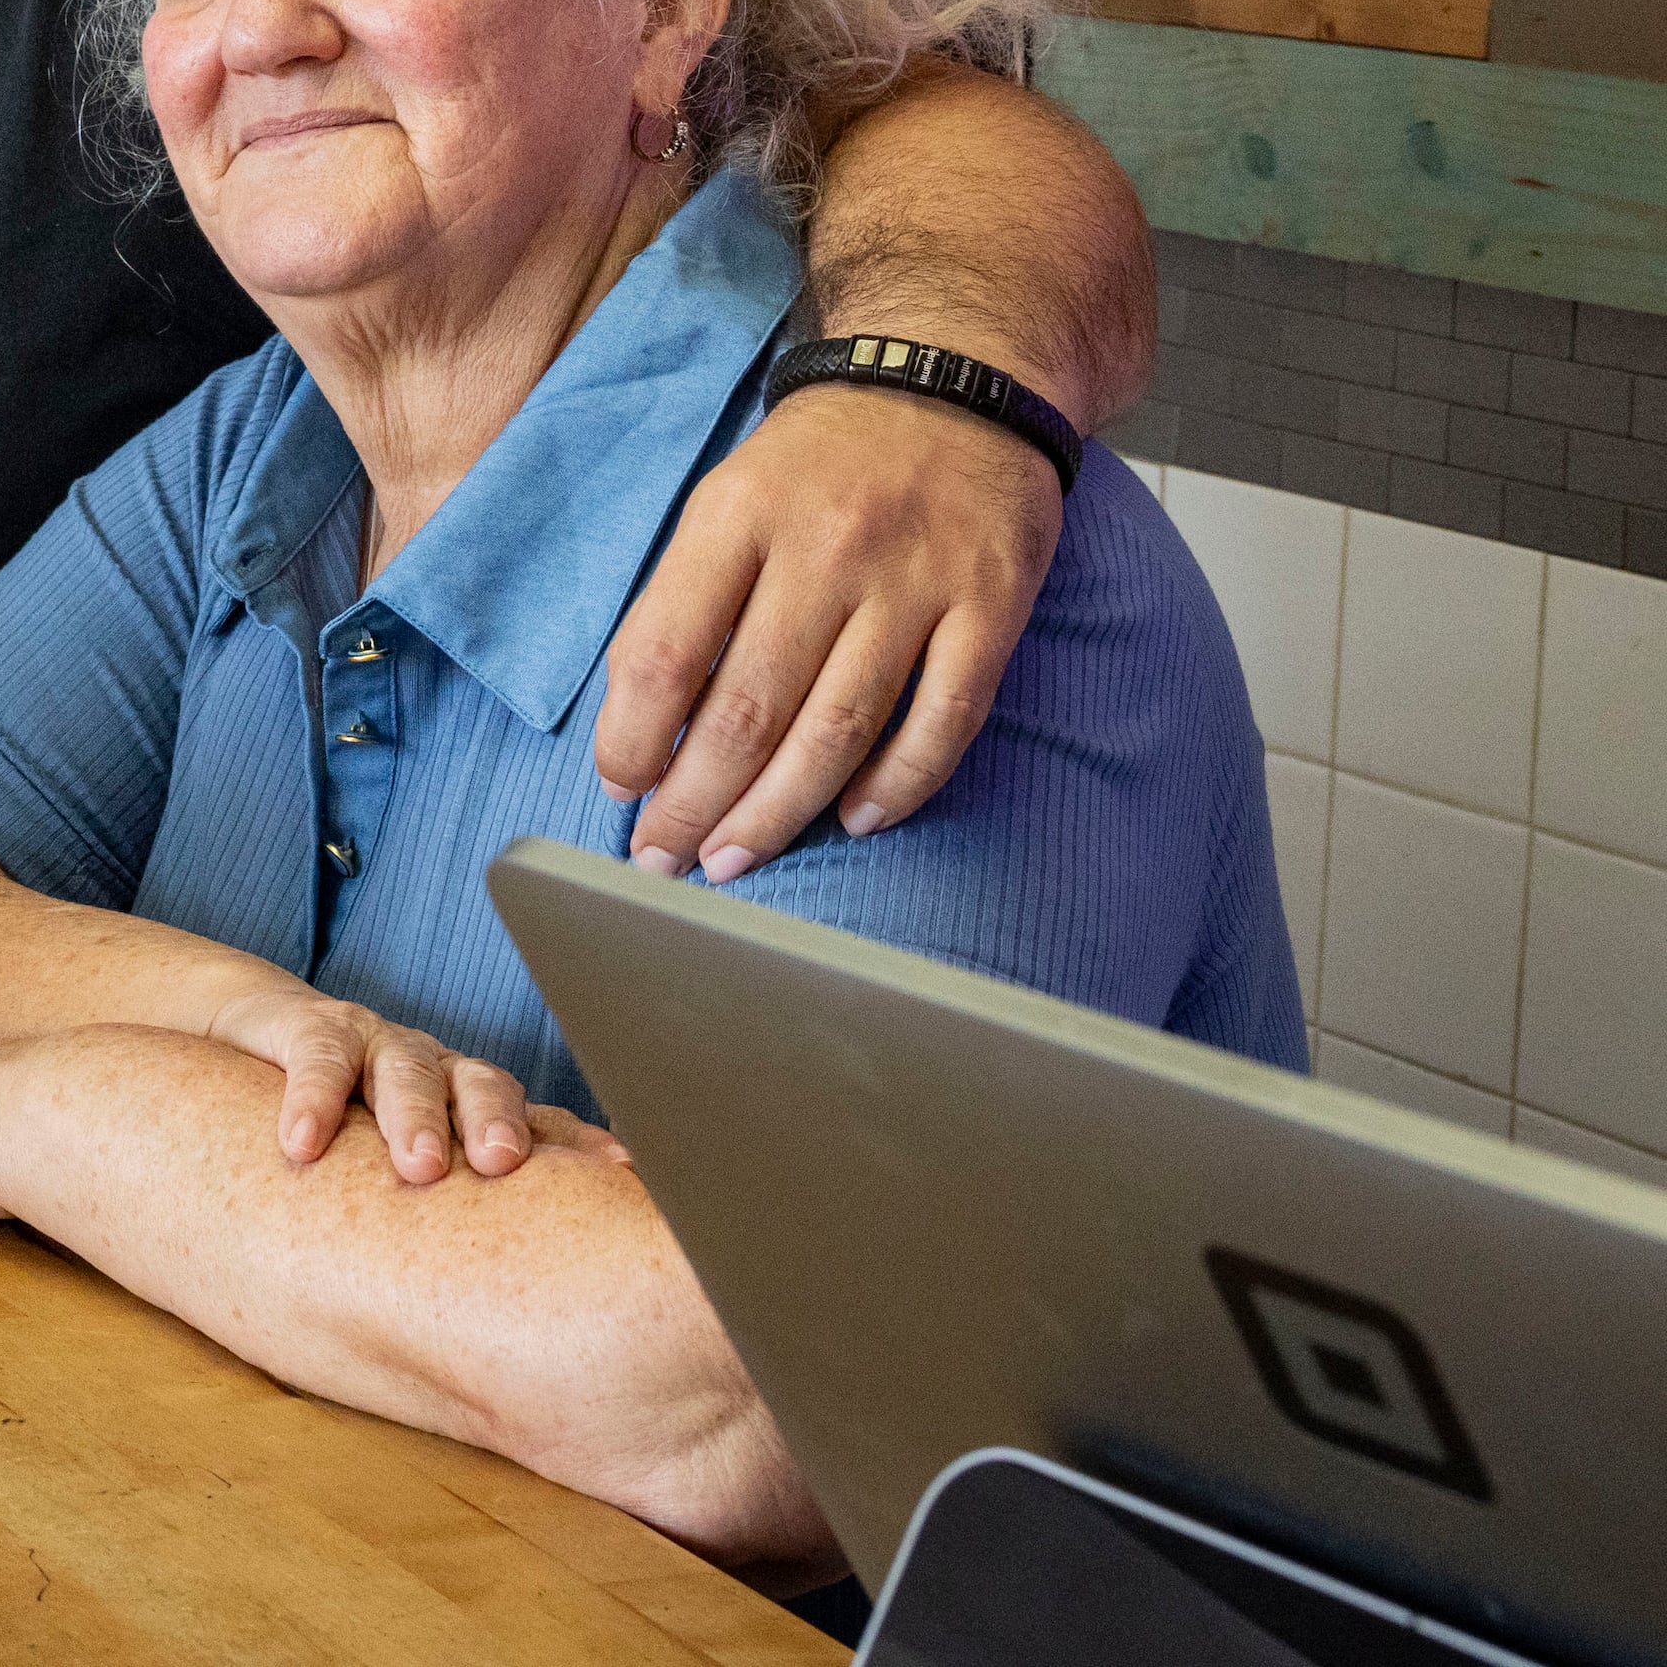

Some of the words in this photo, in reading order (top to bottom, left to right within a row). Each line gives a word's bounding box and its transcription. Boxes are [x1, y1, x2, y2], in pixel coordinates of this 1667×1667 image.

[919, 347, 940, 385] Benjamin
[954, 357, 973, 392] Anthony
[990, 377, 1002, 399] Leah
